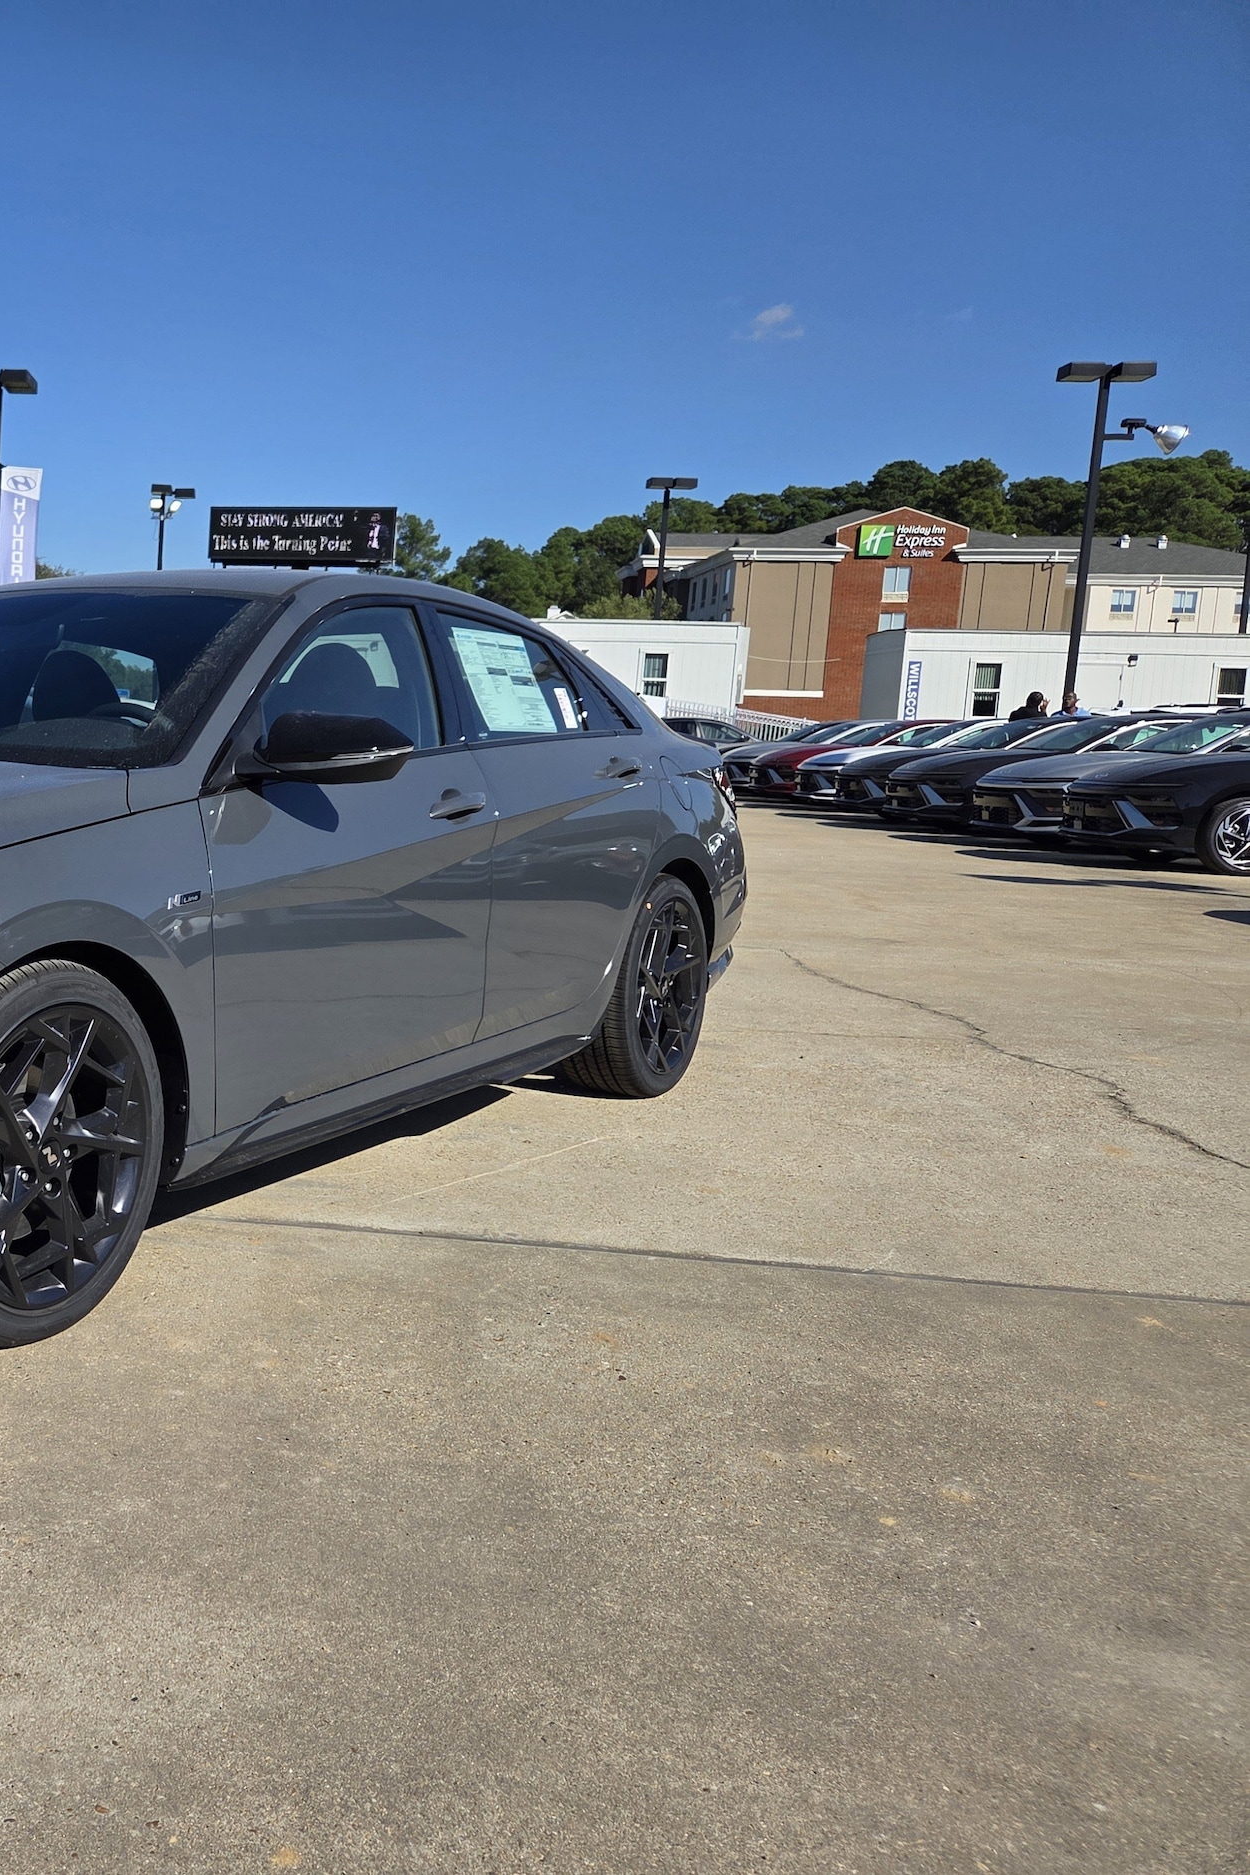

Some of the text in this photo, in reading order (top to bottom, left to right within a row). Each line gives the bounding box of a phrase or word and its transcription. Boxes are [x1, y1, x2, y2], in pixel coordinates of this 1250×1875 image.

[220, 513, 245, 527] STAY
[246, 513, 289, 527] STRONG
[896, 524, 946, 536] Holiday Inn
[212, 534, 352, 555] This is the Turning Point
[895, 534, 945, 549] Express
[902, 549, 934, 557] & Suites
[905, 663, 920, 721] WILLSCOT
